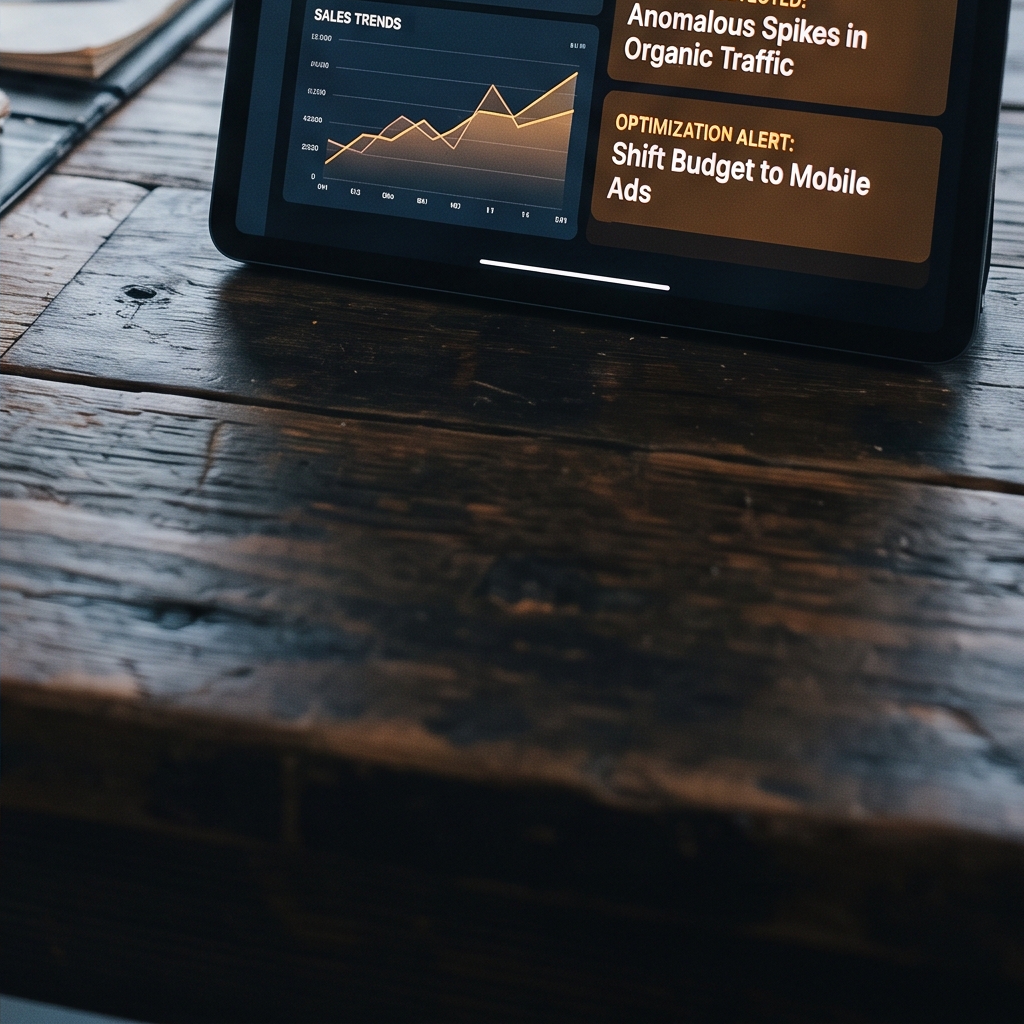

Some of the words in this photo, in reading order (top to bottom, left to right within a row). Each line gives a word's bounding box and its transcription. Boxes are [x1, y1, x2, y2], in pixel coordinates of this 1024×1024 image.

[314, 8, 352, 24] SALES
[354, 12, 402, 30] TRENDS
[627, 2, 756, 38] Anomalous
[760, 15, 841, 48] Spikes
[845, 22, 868, 50] in
[624, 36, 714, 69] Organic
[720, 45, 795, 77] Traffic
[614, 113, 733, 143] OPTIMIZATION
[735, 128, 795, 153] ALERT:
[611, 141, 666, 171] Shift
[670, 148, 756, 184] Budget
[759, 160, 784, 186] to
[789, 162, 871, 196] Mobile
[606, 176, 652, 204] Ads
